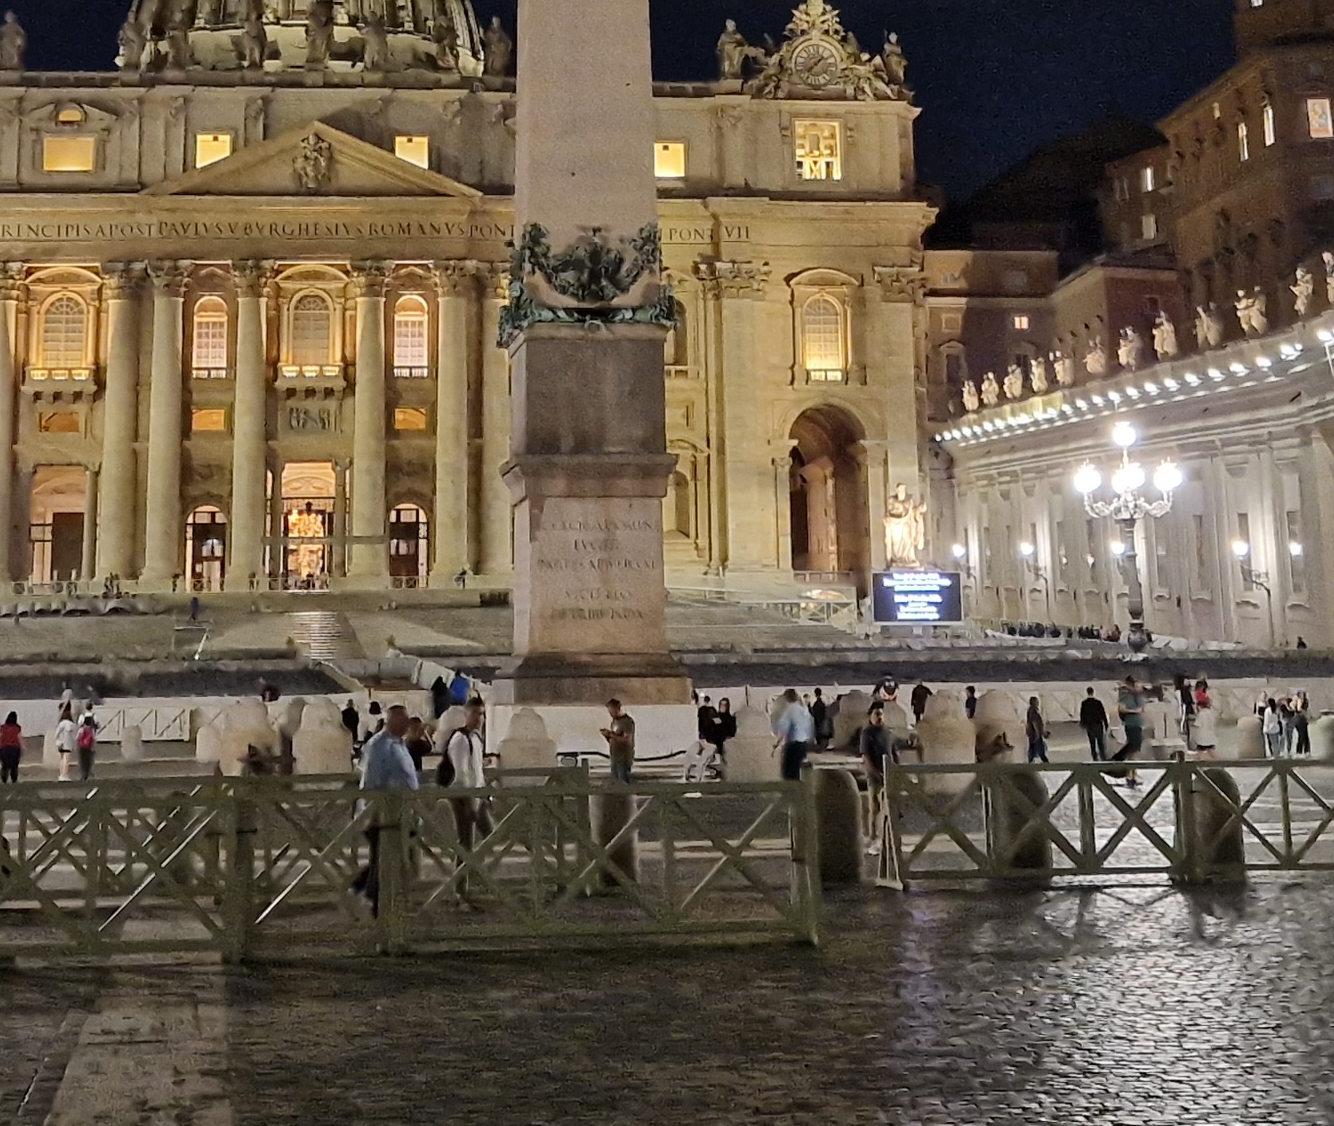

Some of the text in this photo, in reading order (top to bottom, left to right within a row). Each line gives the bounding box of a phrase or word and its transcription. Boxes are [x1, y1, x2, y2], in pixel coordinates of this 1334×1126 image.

[95, 222, 153, 238] APOST
[369, 221, 465, 237] ROMANVS
[724, 225, 750, 240] VII
